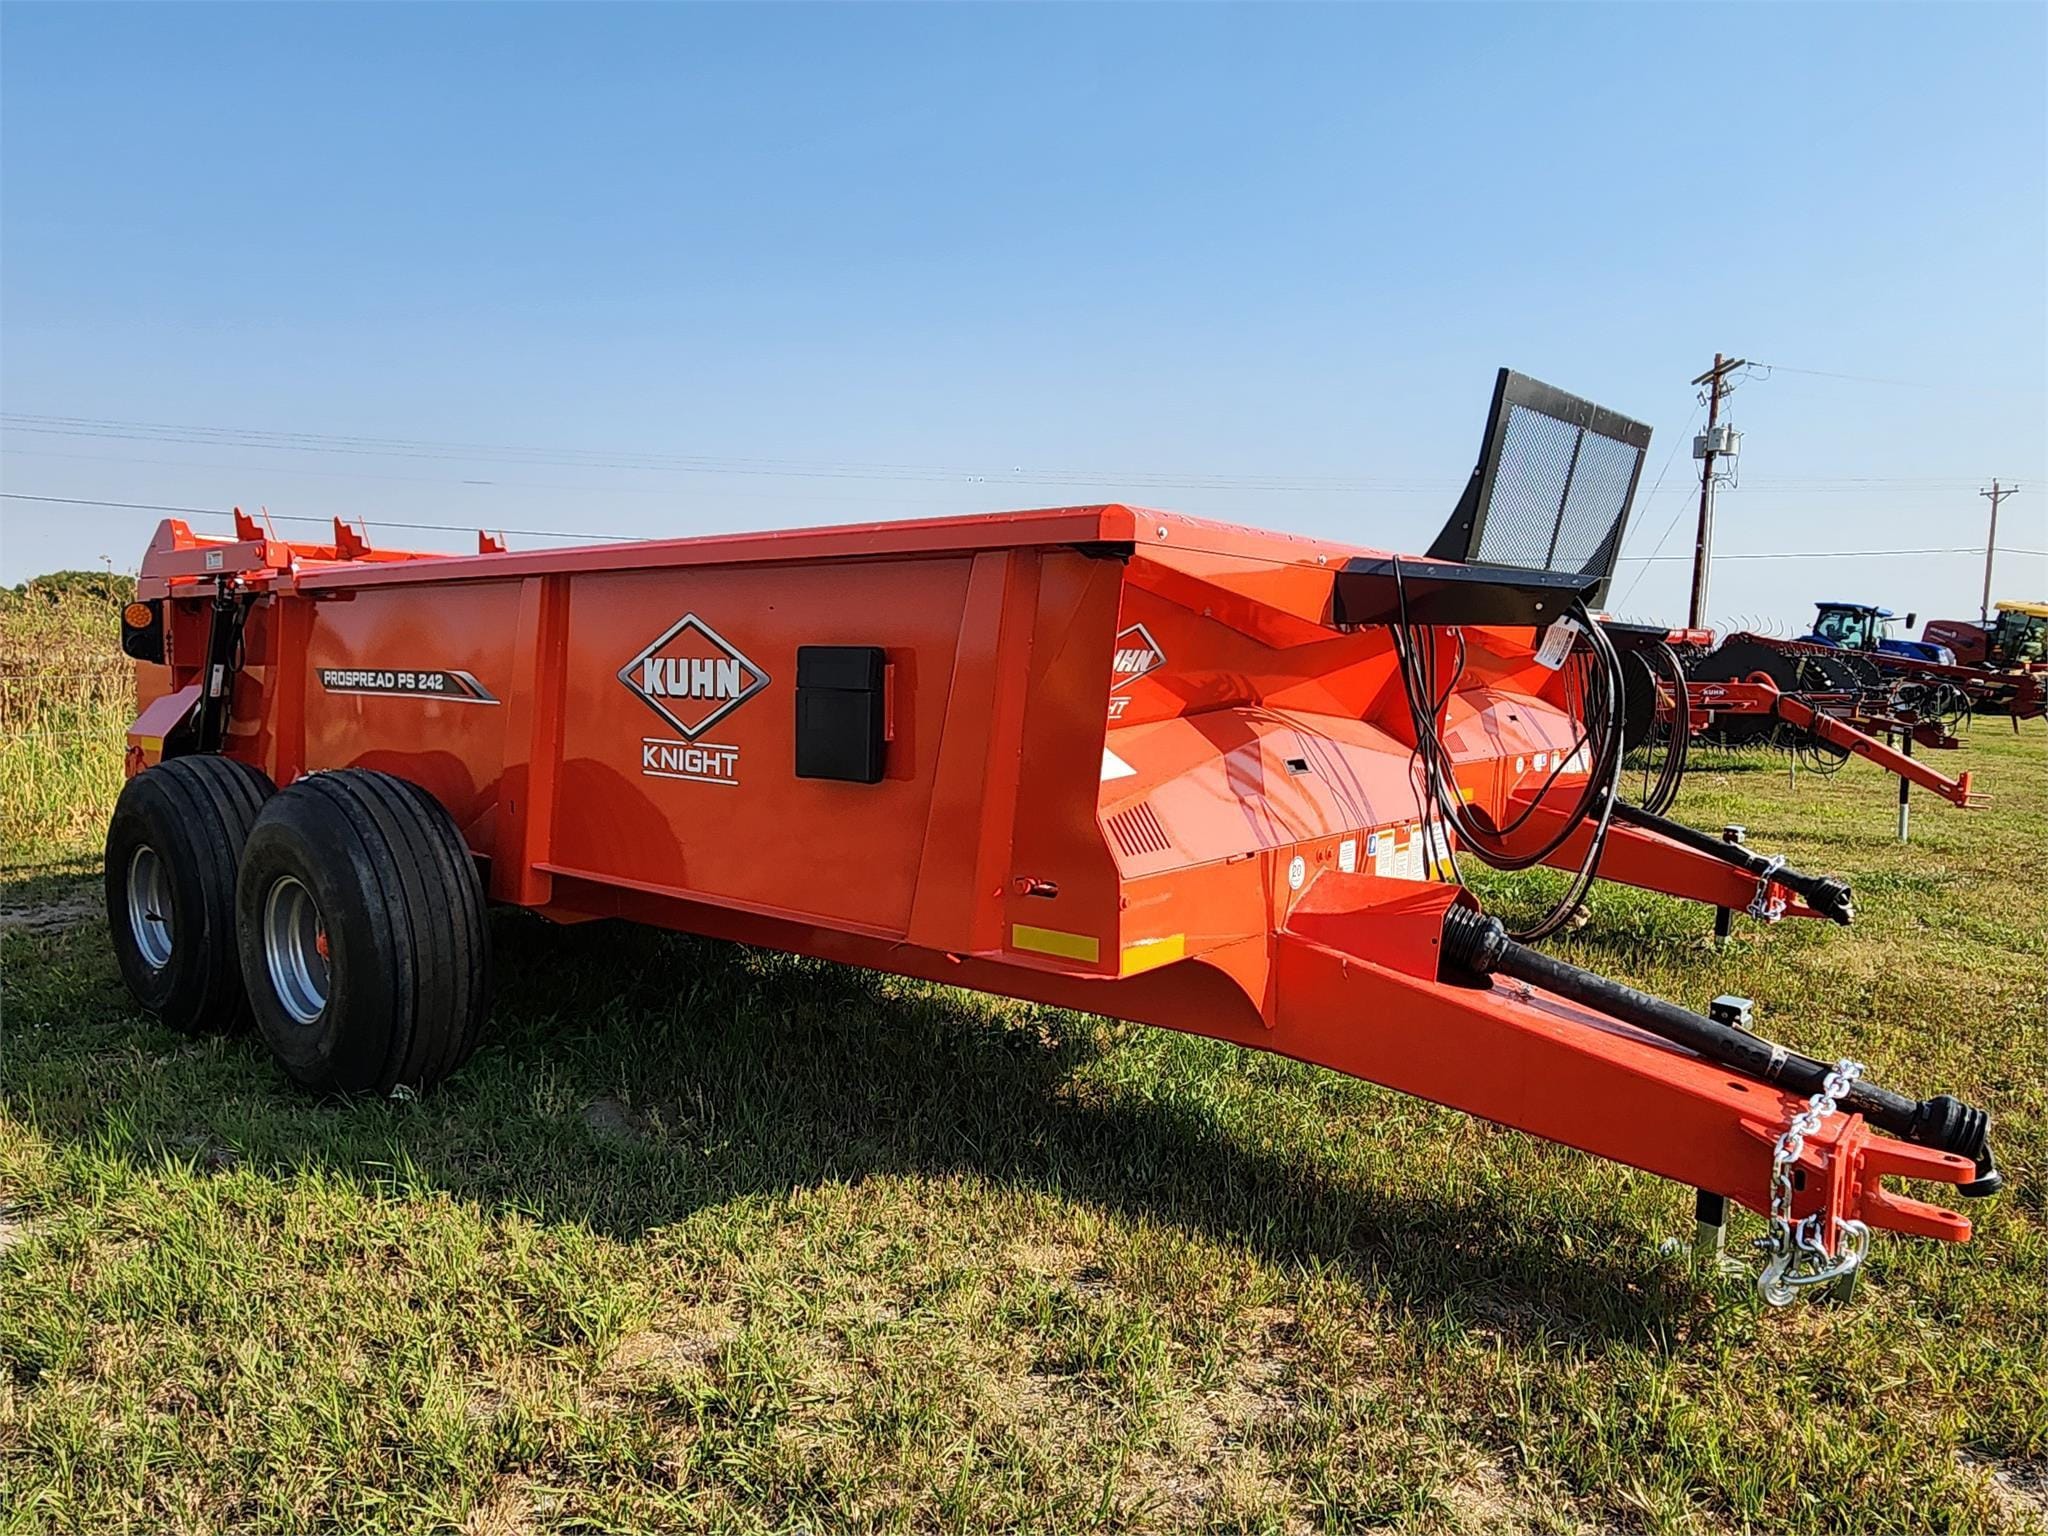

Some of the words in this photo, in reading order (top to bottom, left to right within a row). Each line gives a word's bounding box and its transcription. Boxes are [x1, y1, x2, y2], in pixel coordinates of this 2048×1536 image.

[324, 671, 394, 688] PROSPREAD
[398, 673, 415, 689] PS
[418, 674, 443, 690] 242
[643, 657, 740, 698] KUHN
[643, 745, 738, 777] KNIGHT
